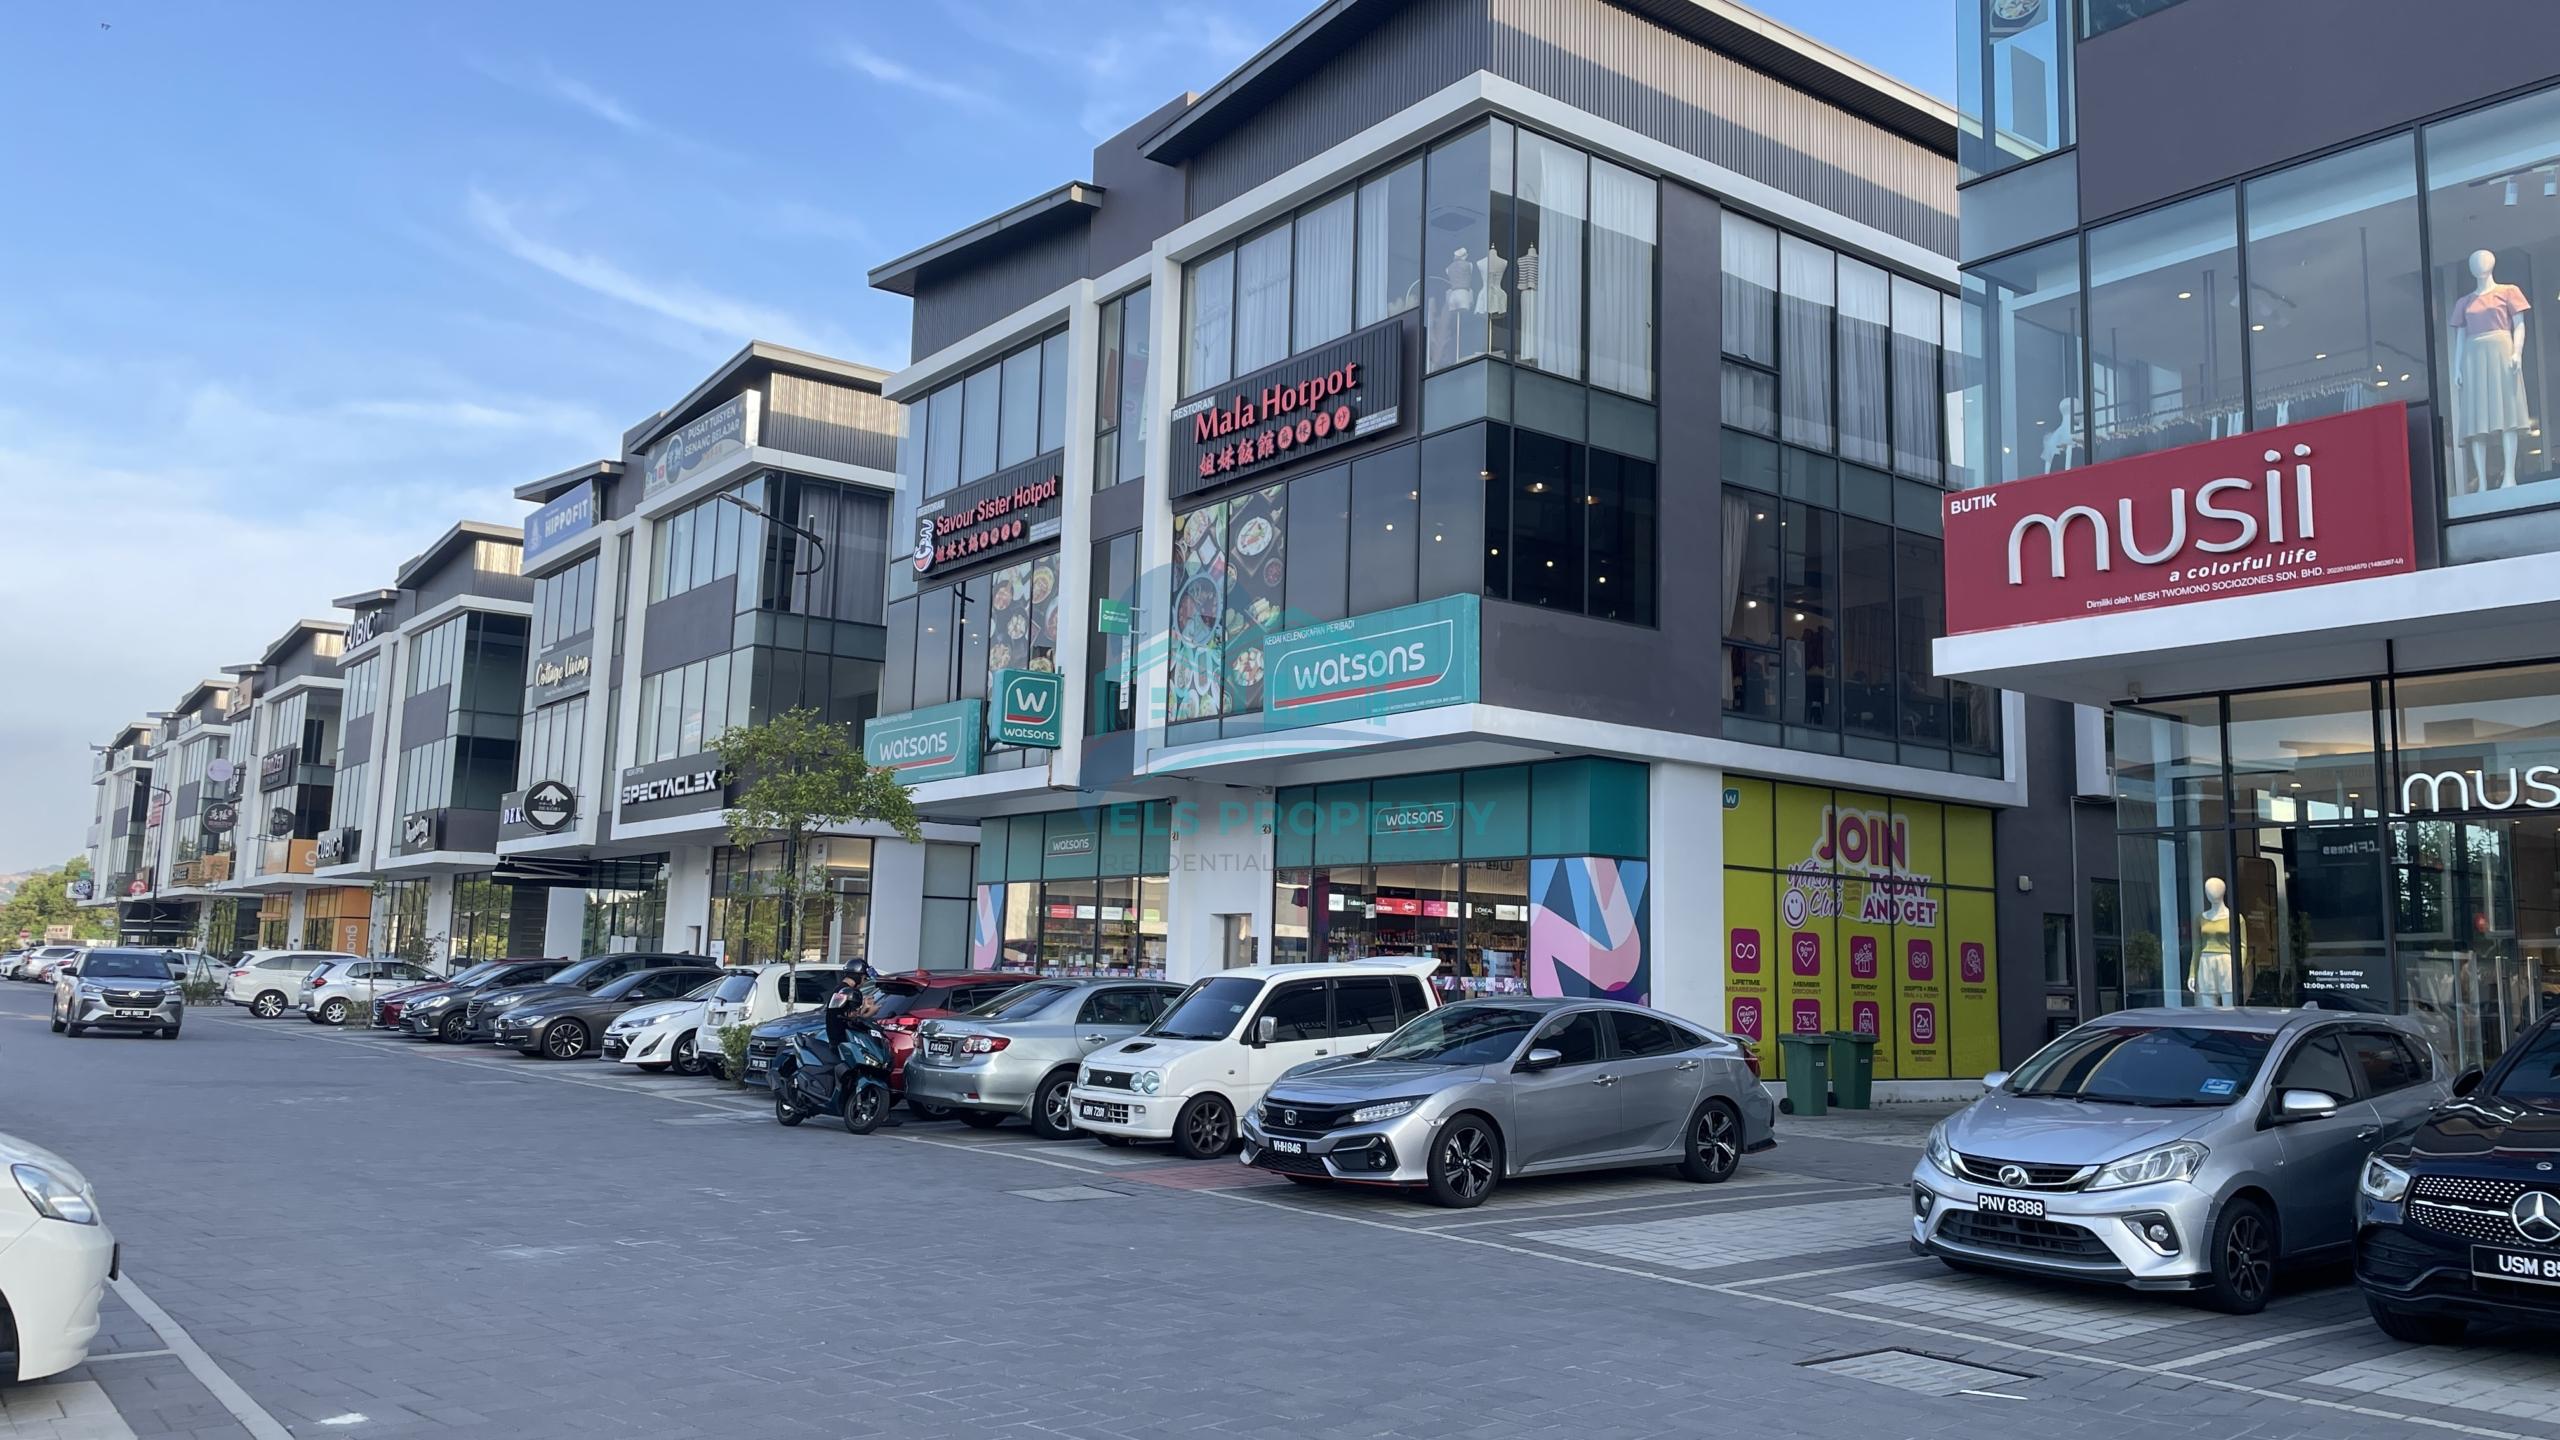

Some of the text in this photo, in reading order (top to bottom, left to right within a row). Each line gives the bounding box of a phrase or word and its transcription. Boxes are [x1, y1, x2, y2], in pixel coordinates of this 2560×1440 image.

[1173, 397, 1216, 420] RESTORAN
[1195, 362, 1357, 444] Mala Hotpot
[684, 435, 711, 457] SENANG
[712, 419, 740, 443] BELAJAR
[688, 421, 709, 440] PUSAT
[936, 508, 976, 537] Savour
[977, 495, 1011, 522] Sister
[1014, 474, 1056, 509] Hotpot
[1950, 493, 1998, 515] BUTIK
[2008, 442, 2315, 585] musii
[544, 499, 588, 538] HIPPOFIT
[2169, 548, 2317, 582] a colorful life
[2134, 589, 2160, 602] MESH
[2161, 582, 2210, 599] TWOMONO
[2212, 574, 2274, 592] SOCIOZONES
[2276, 571, 2298, 583] SDN.
[2301, 567, 2325, 579] BHD.
[343, 611, 376, 651] CUBIC
[1264, 636, 1282, 646] KEDAI
[1327, 619, 1355, 633] PERIBADI
[535, 655, 588, 687] Cottage Living
[1294, 642, 1426, 690] watsons
[879, 732, 948, 761] watsons
[1003, 726, 1056, 741] watsons
[621, 770, 718, 805] SPECTACLEX
[1385, 810, 1444, 826] watsons
[316, 837, 338, 859] CUBIC
[1053, 837, 1089, 851] watsons
[1818, 812, 1906, 868] JOIN
[1869, 873, 1929, 898] TODAY
[1810, 889, 1843, 917] Club
[1863, 898, 1936, 924] AND GET
[1916, 1014, 1929, 1028] 2x
[1979, 1195, 2044, 1216] PNV 8388
[2498, 1254, 2539, 1276] USM
